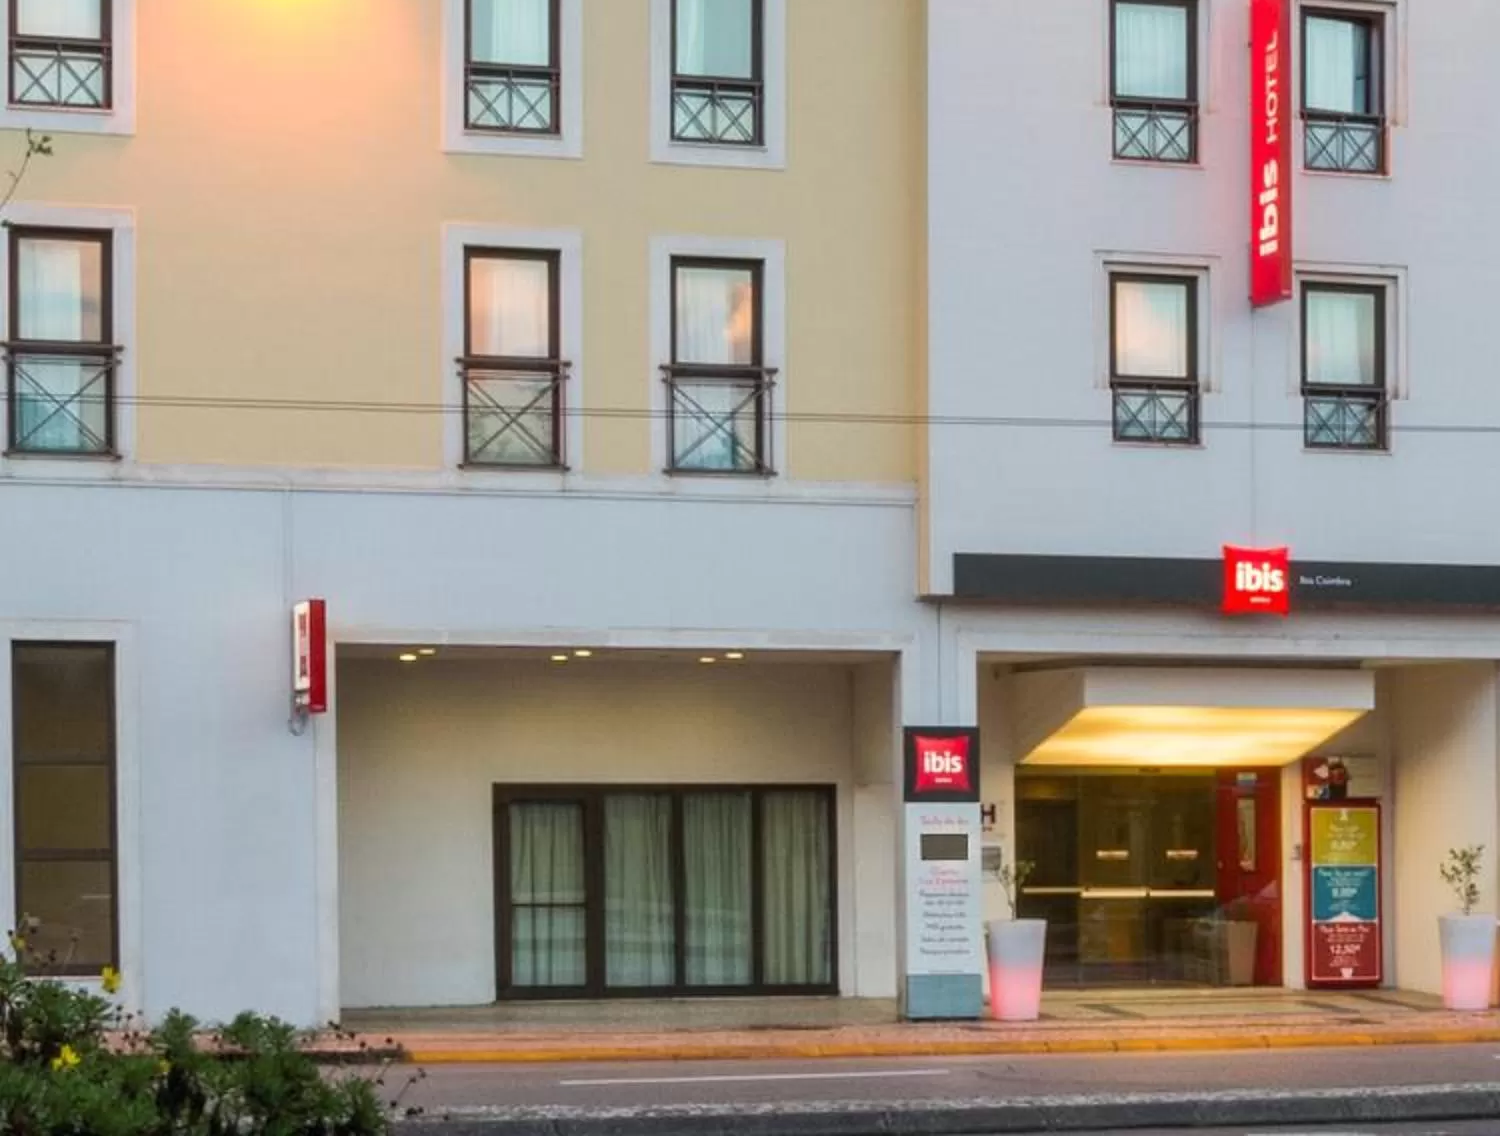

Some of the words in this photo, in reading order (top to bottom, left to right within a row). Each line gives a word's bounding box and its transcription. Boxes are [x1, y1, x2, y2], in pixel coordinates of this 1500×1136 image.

[1265, 30, 1278, 143] HOTEL
[1260, 159, 1278, 257] ibis
[1235, 560, 1284, 592] ibis
[923, 750, 963, 773] ibis
